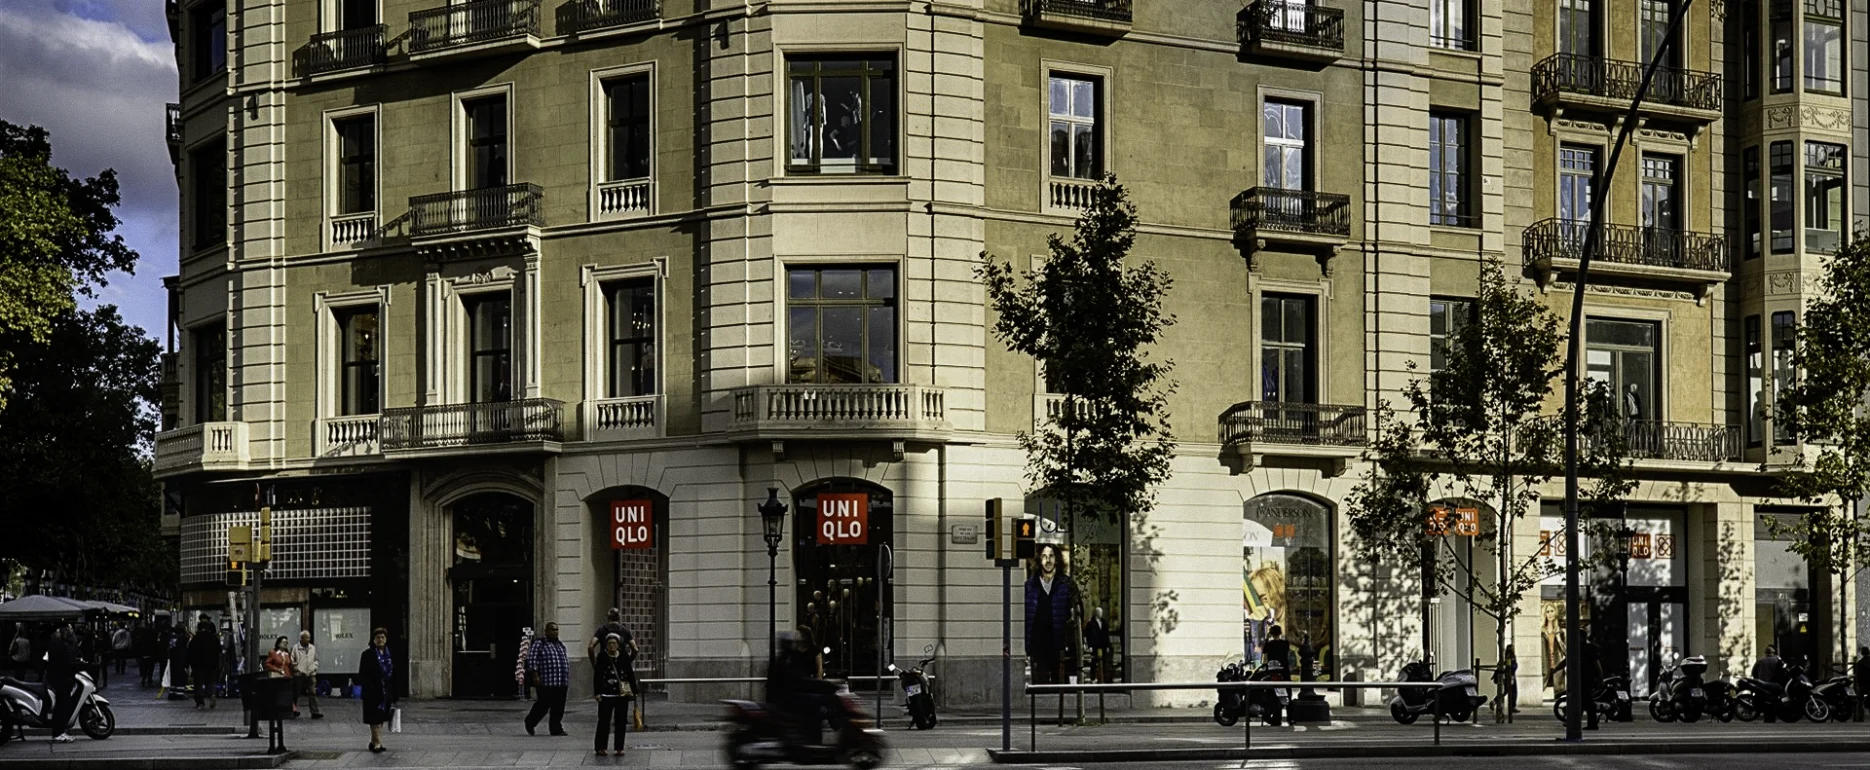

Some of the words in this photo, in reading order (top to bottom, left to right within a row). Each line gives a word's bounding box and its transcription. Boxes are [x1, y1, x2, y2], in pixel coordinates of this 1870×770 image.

[615, 506, 645, 523] UNI
[823, 500, 858, 518] UNI
[615, 526, 648, 546] QLO
[823, 520, 862, 541] QLO
[1631, 535, 1648, 546] UNI
[1632, 546, 1650, 557] QLO
